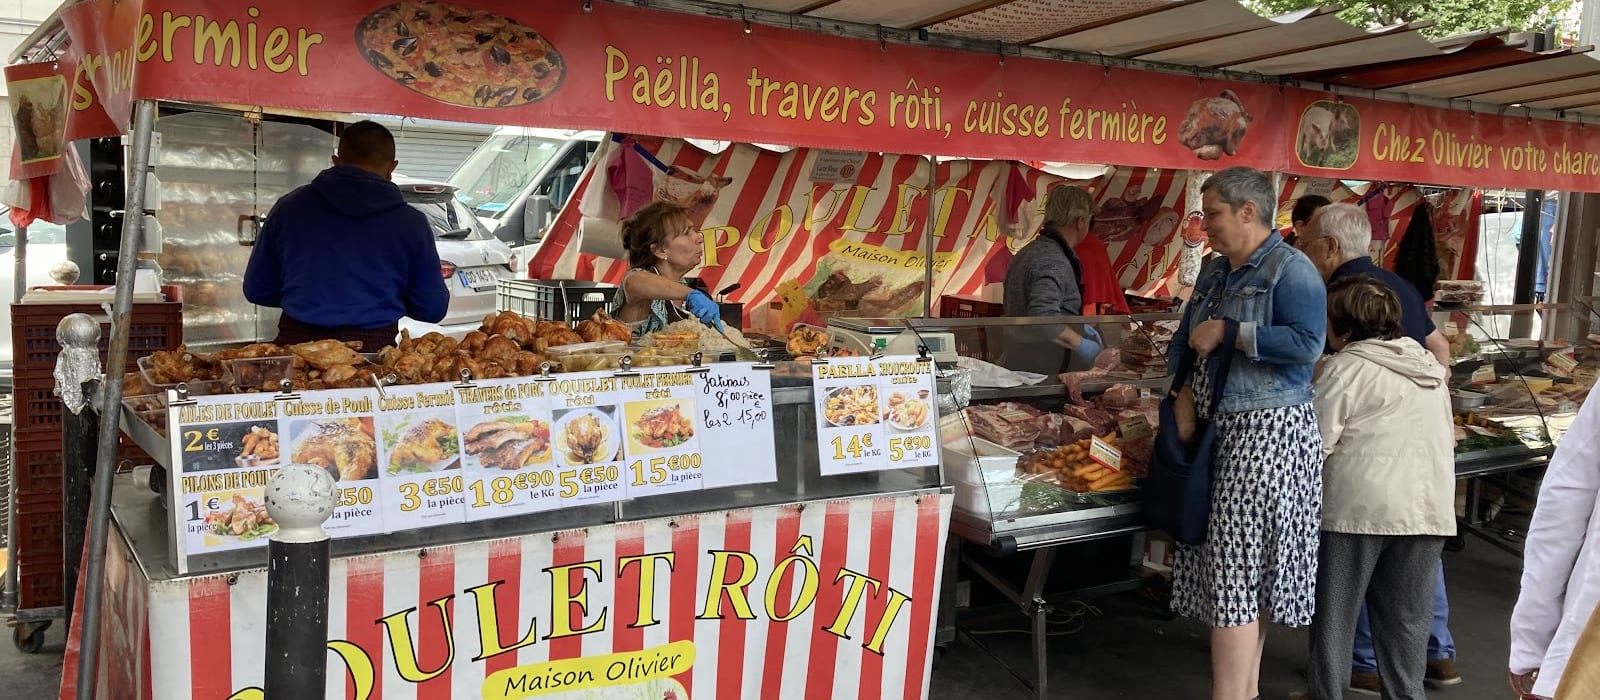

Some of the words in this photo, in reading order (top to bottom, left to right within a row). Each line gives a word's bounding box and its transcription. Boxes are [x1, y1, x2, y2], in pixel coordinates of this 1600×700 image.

[135, 7, 324, 76] ermier
[604, 44, 731, 122] Paëlla,
[746, 67, 877, 126] travers
[888, 77, 951, 139] rôti,
[964, 91, 1049, 138] cuisse
[1059, 96, 1167, 145] fermière
[1372, 122, 1425, 163] Chez
[1431, 128, 1492, 169] Olivier
[1501, 140, 1547, 172] votre
[699, 184, 973, 268] POULET
[841, 245, 898, 265] Maison
[458, 385, 503, 404] TRAVERS
[505, 383, 517, 400] de
[517, 382, 544, 399] PORC
[549, 376, 617, 396] OQUELET
[282, 399, 322, 417] Cuisse
[325, 398, 340, 415] de
[377, 394, 414, 412] Cuisse
[483, 401, 522, 415] rôtis
[566, 394, 595, 407] rôti
[179, 404, 214, 422] AILES
[215, 403, 234, 421] DE
[204, 441, 212, 451] les
[217, 440, 234, 452] pièces
[871, 449, 881, 457] KG
[922, 450, 932, 458] KG
[181, 473, 224, 494] PILONS
[224, 472, 240, 490] DE
[671, 472, 679, 482] la
[680, 469, 702, 483] pièce
[336, 486, 373, 507] €50
[530, 490, 539, 499] le
[541, 488, 555, 498] KG
[584, 484, 592, 493] la
[594, 481, 618, 494] pièce
[427, 499, 437, 508] la
[344, 508, 372, 521] pièce
[187, 524, 195, 533] la
[694, 534, 913, 657] RÔTI
[504, 667, 594, 697] Maison
[606, 652, 682, 681] Olivier
